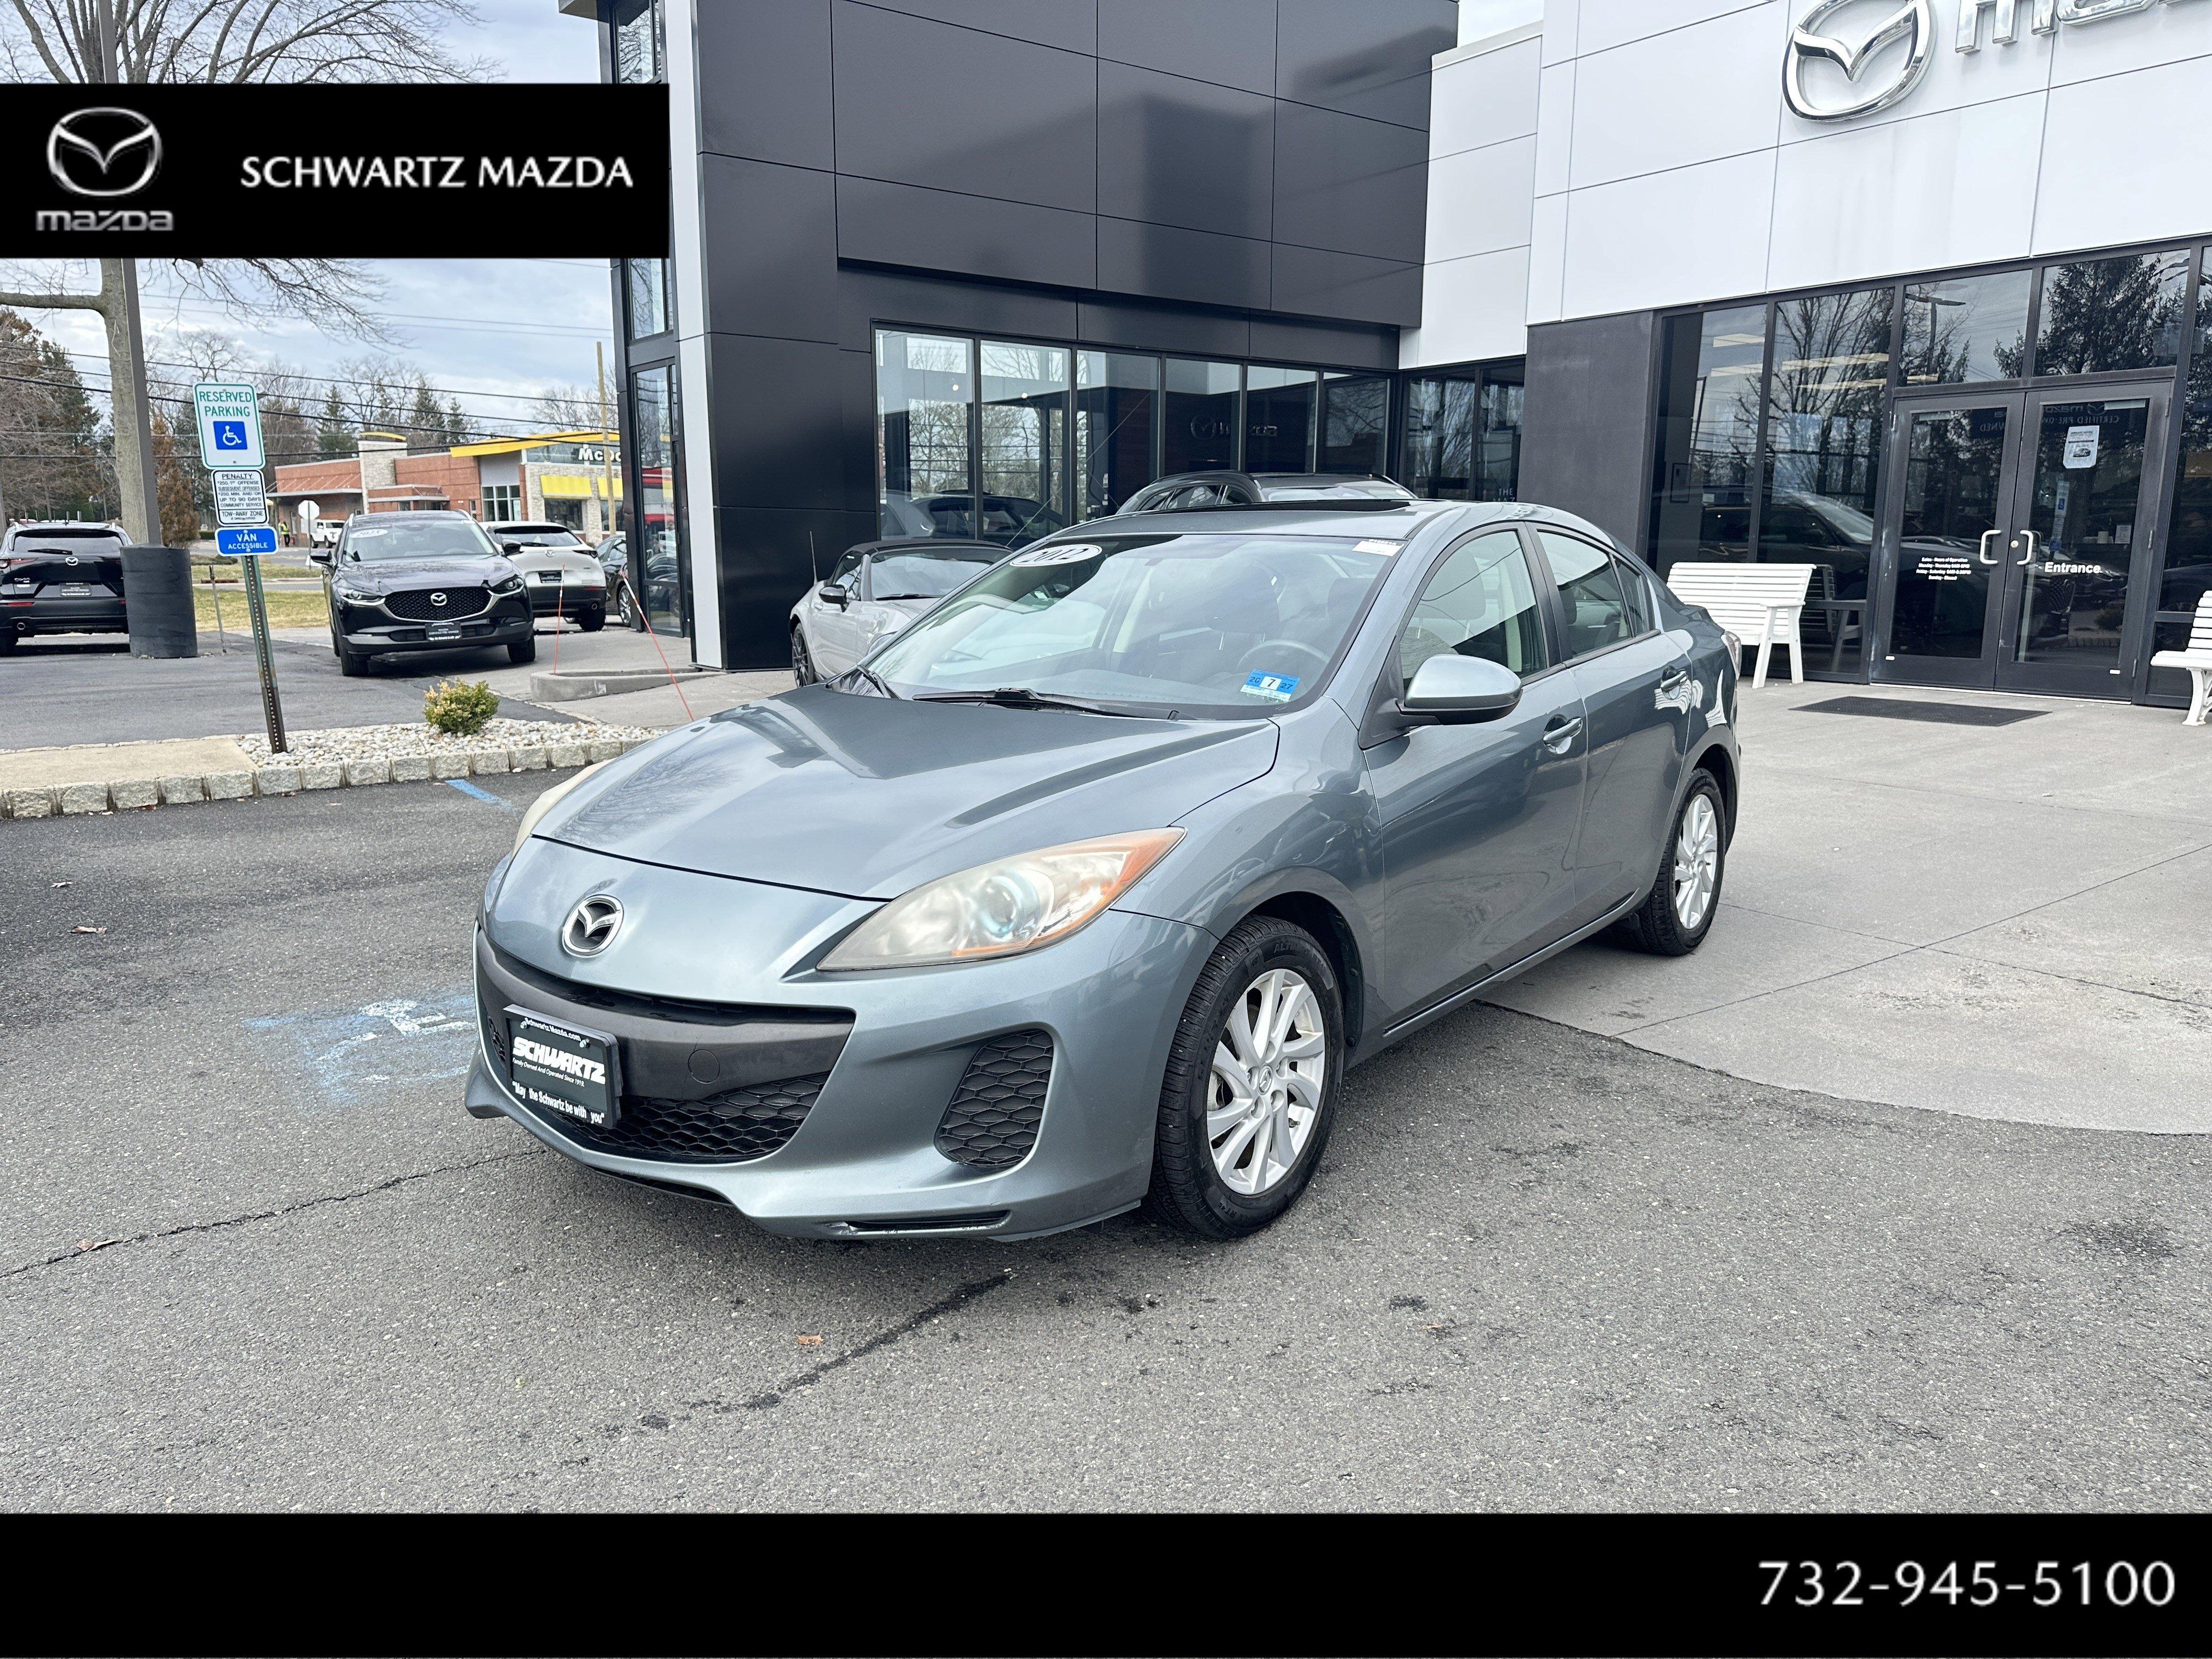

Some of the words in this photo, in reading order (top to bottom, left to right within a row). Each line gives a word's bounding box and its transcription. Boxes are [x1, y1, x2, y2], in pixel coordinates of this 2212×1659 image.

[199, 391, 252, 402] RESERVED
[205, 406, 250, 416] PARKING
[236, 533, 257, 542] VAN
[1018, 548, 1090, 563] 2012
[2045, 562, 2102, 573] Entrance.
[1267, 679, 1276, 687] 7
[512, 1036, 606, 1085] SCHWARTZ
[512, 1057, 523, 1068] Family
[523, 1062, 538, 1071] Owned
[546, 1069, 565, 1079] Operated
[564, 1074, 574, 1083] Since
[529, 1088, 538, 1101] the
[539, 1091, 565, 1111] Schwartz
[565, 1100, 573, 1114] be
[573, 1105, 587, 1119] with
